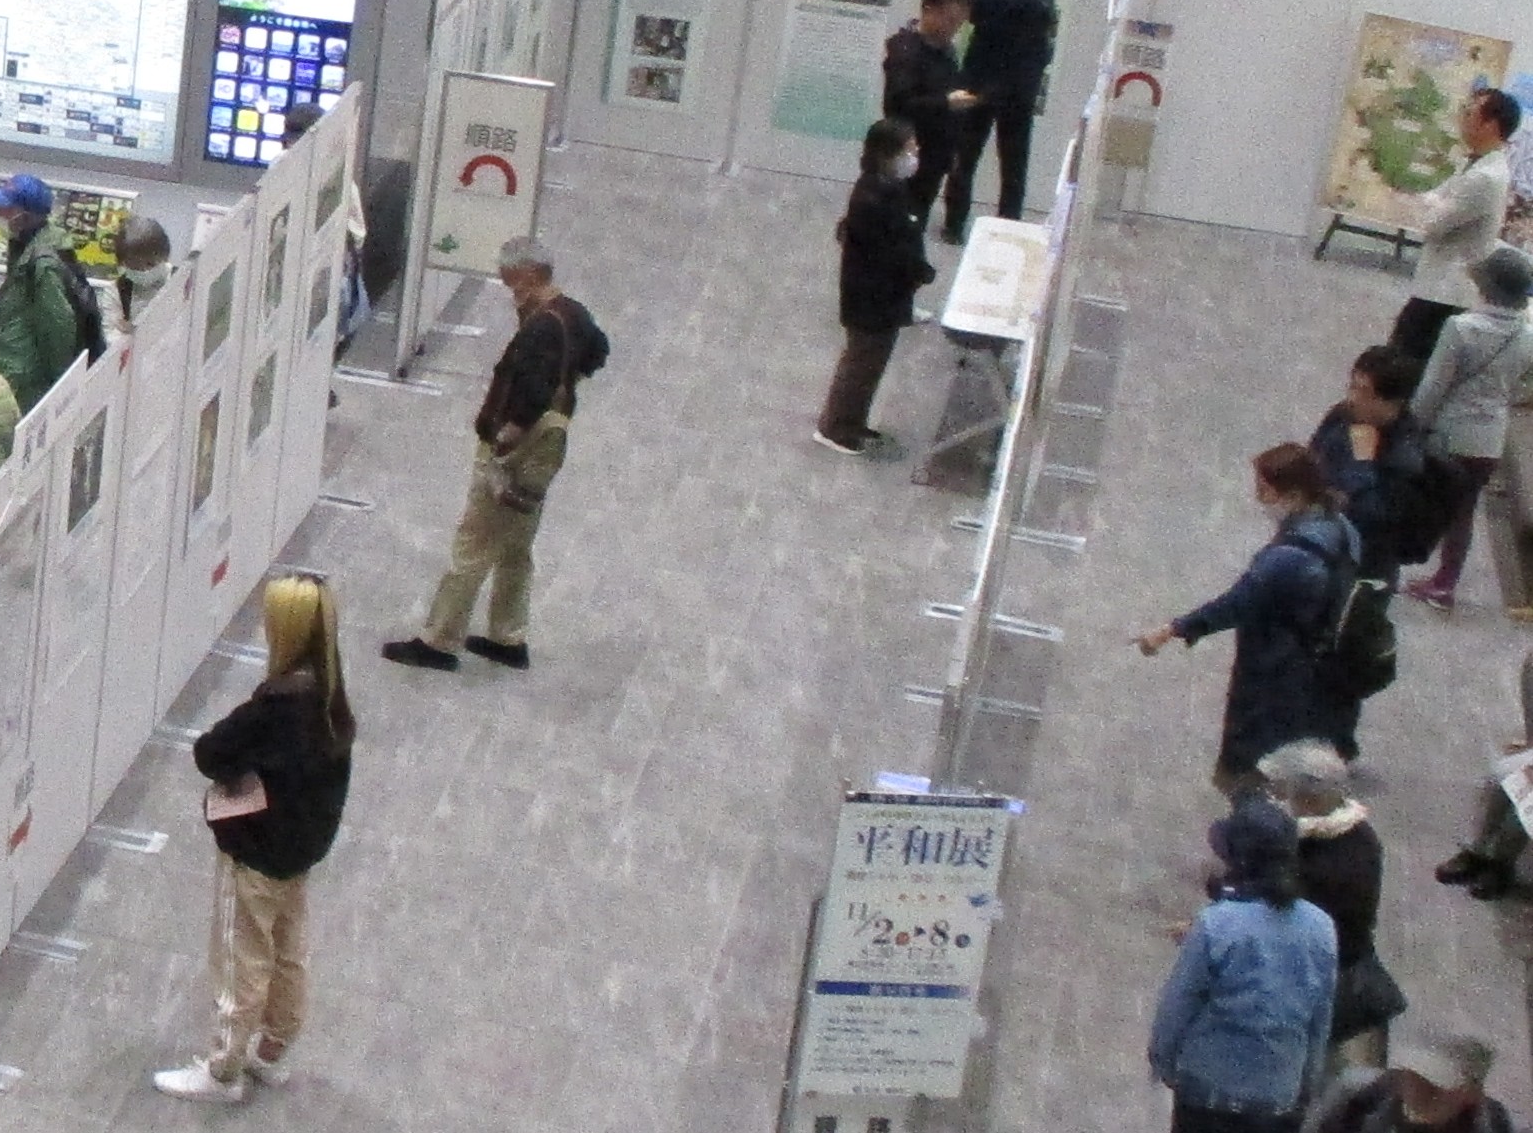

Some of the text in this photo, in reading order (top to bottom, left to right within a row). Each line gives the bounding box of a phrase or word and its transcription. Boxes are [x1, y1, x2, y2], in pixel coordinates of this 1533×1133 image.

[464, 123, 519, 153] 順路
[855, 823, 995, 869] 平和展
